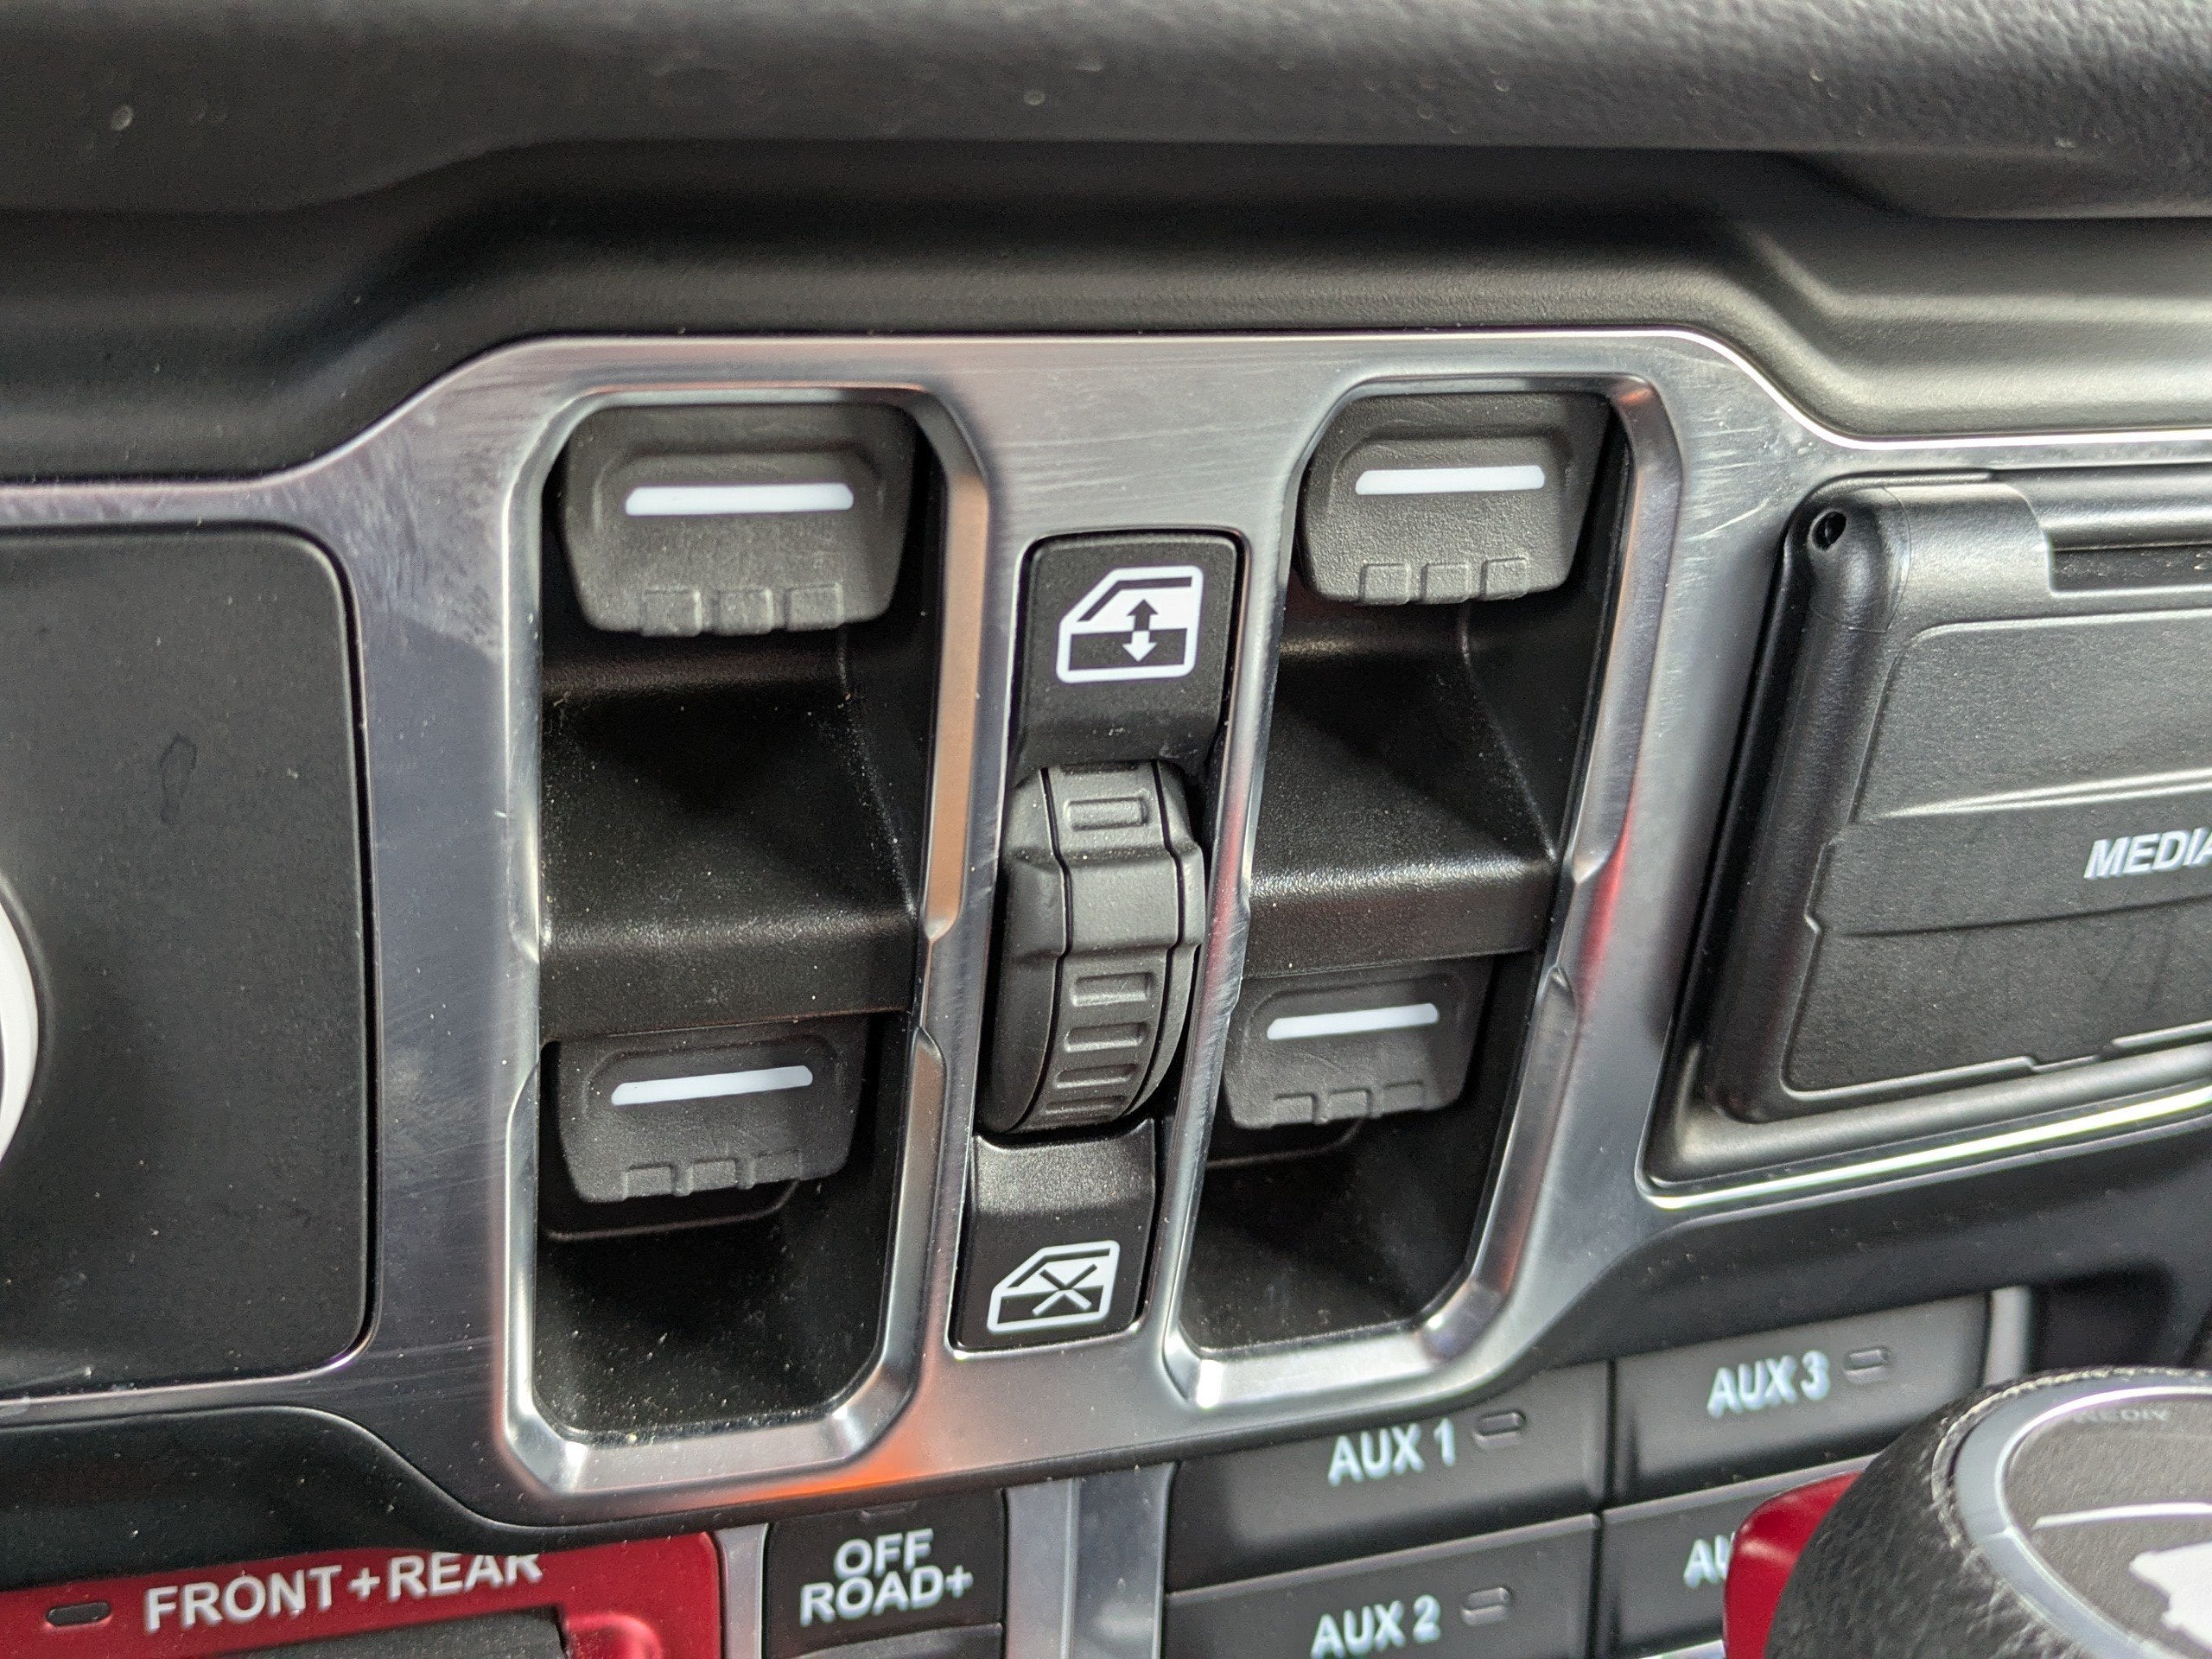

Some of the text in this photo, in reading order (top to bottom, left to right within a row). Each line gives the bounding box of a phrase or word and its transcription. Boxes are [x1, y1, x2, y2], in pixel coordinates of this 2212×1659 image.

[1707, 1349, 1831, 1419] AUX 3
[1328, 1417, 1457, 1488] AUX 1
[833, 1528, 934, 1580] OFF
[1682, 1531, 1736, 1589] AU
[799, 1565, 975, 1627] ROAD+
[1310, 1594, 1442, 1659] AUX 2
